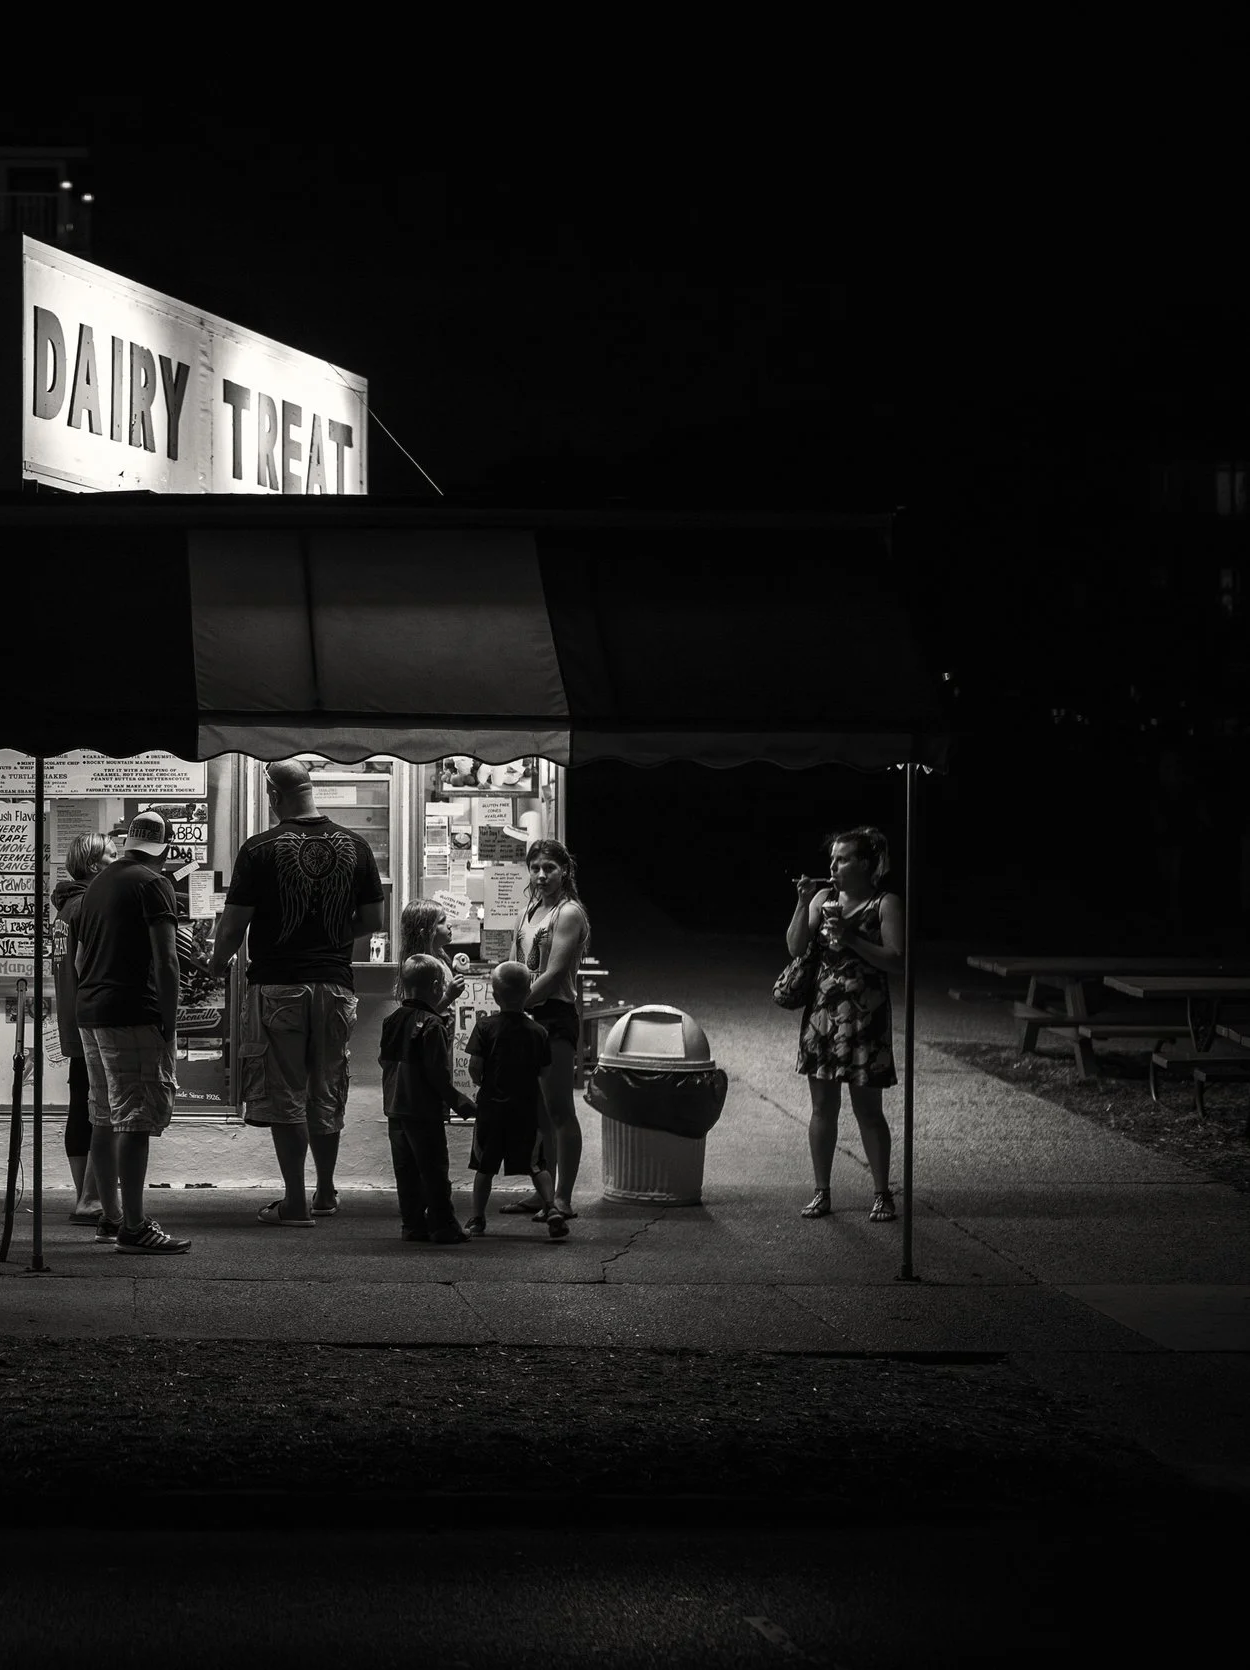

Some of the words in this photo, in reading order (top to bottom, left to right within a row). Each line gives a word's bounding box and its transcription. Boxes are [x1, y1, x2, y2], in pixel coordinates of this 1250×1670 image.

[32, 305, 190, 461] DAIRY
[222, 379, 354, 495] TREAT
[177, 826, 204, 841] BBQ
[170, 846, 195, 864] Dog
[439, 894, 456, 904] GLUTEN
[443, 901, 457, 909] CONES
[189, 1092, 204, 1100] Since
